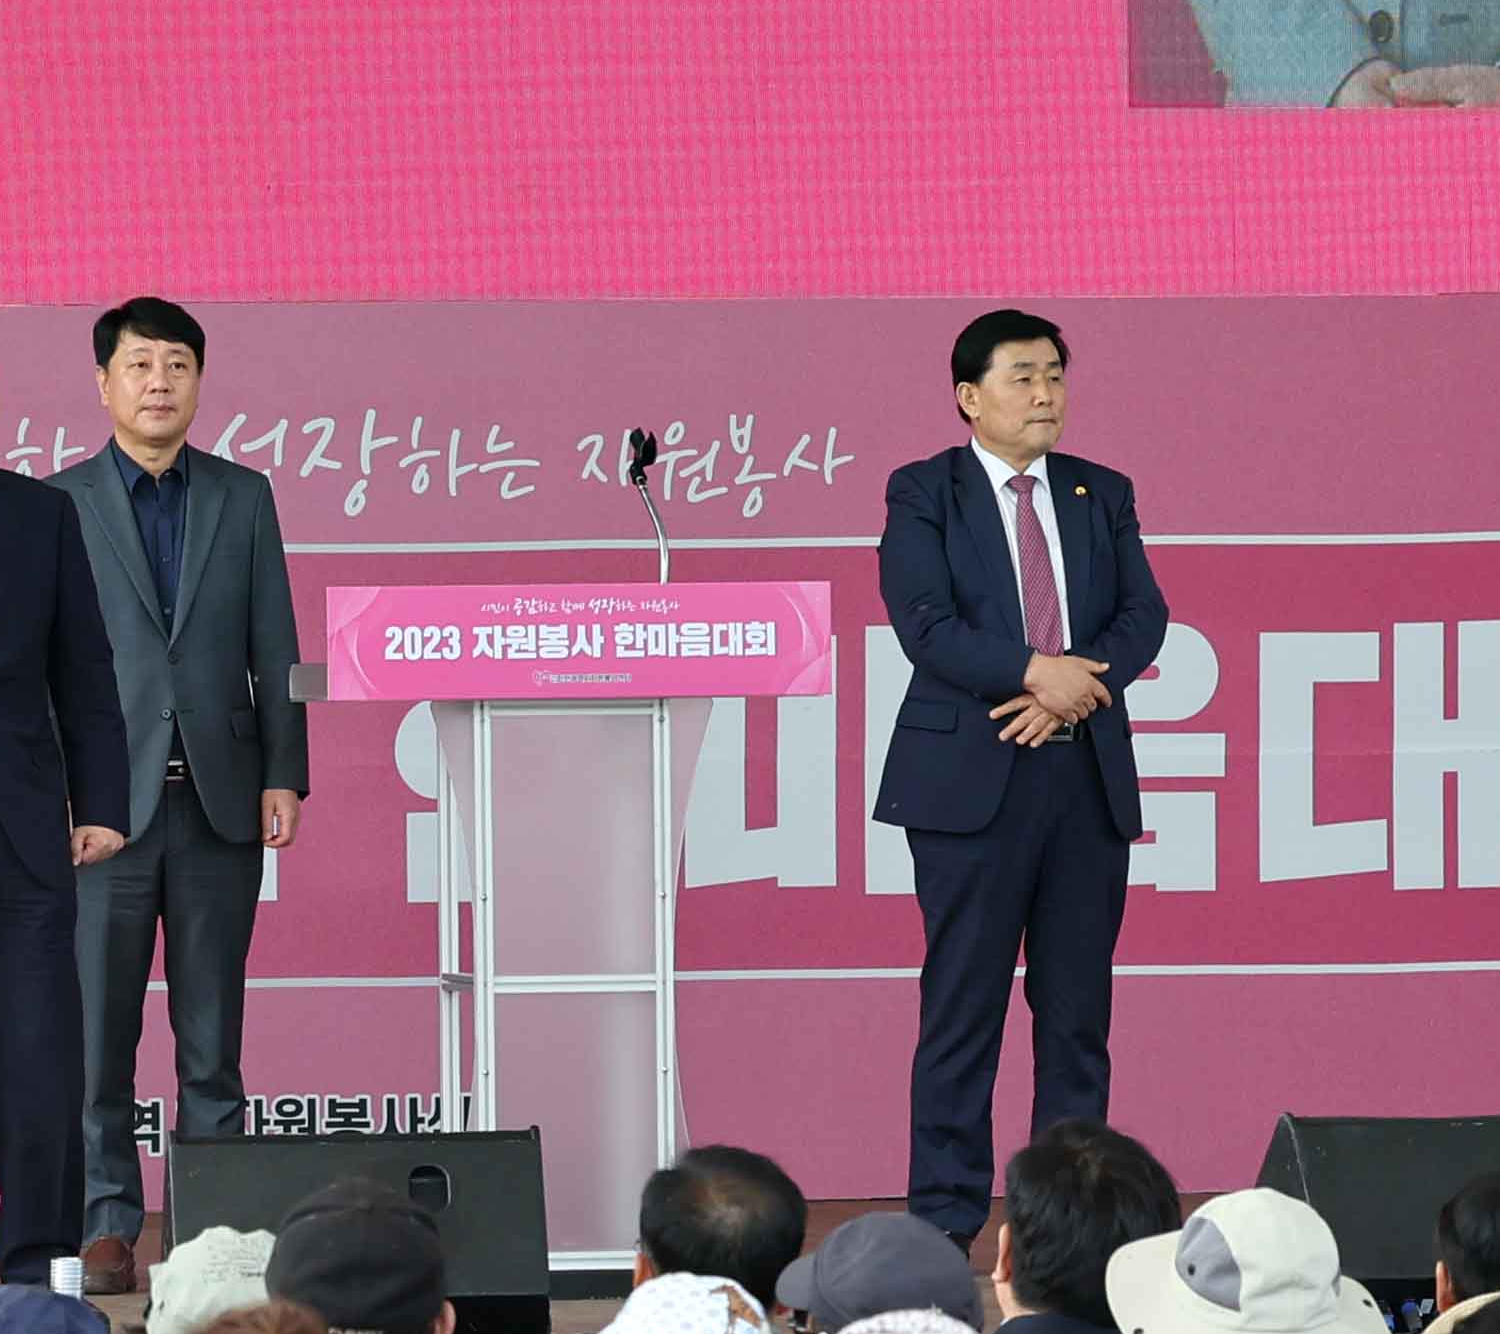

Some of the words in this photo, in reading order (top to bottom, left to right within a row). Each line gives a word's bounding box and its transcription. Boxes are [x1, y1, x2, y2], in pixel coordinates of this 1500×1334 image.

[576, 413, 855, 518] 자원봉사
[385, 625, 461, 660] 2023
[472, 623, 605, 660] 자원봉사
[614, 621, 778, 658] 한마음대회
